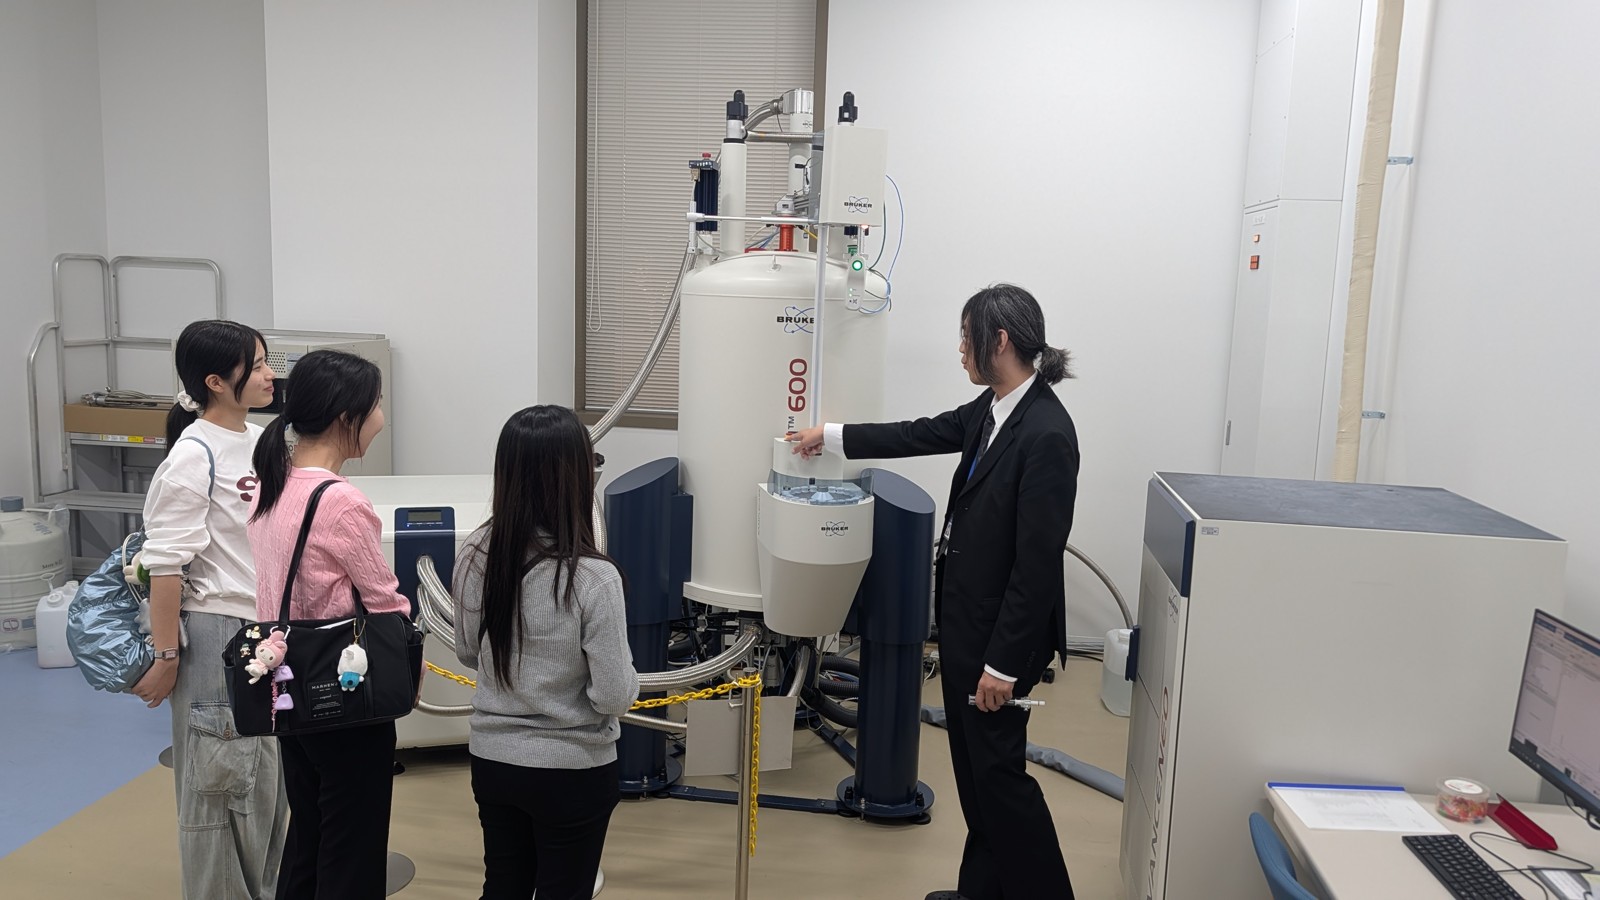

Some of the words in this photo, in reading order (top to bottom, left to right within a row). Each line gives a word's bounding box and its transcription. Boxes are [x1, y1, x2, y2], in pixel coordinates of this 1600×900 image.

[776, 316, 815, 324] BRUKE
[788, 358, 808, 412] 600
[788, 416, 795, 430] TM
